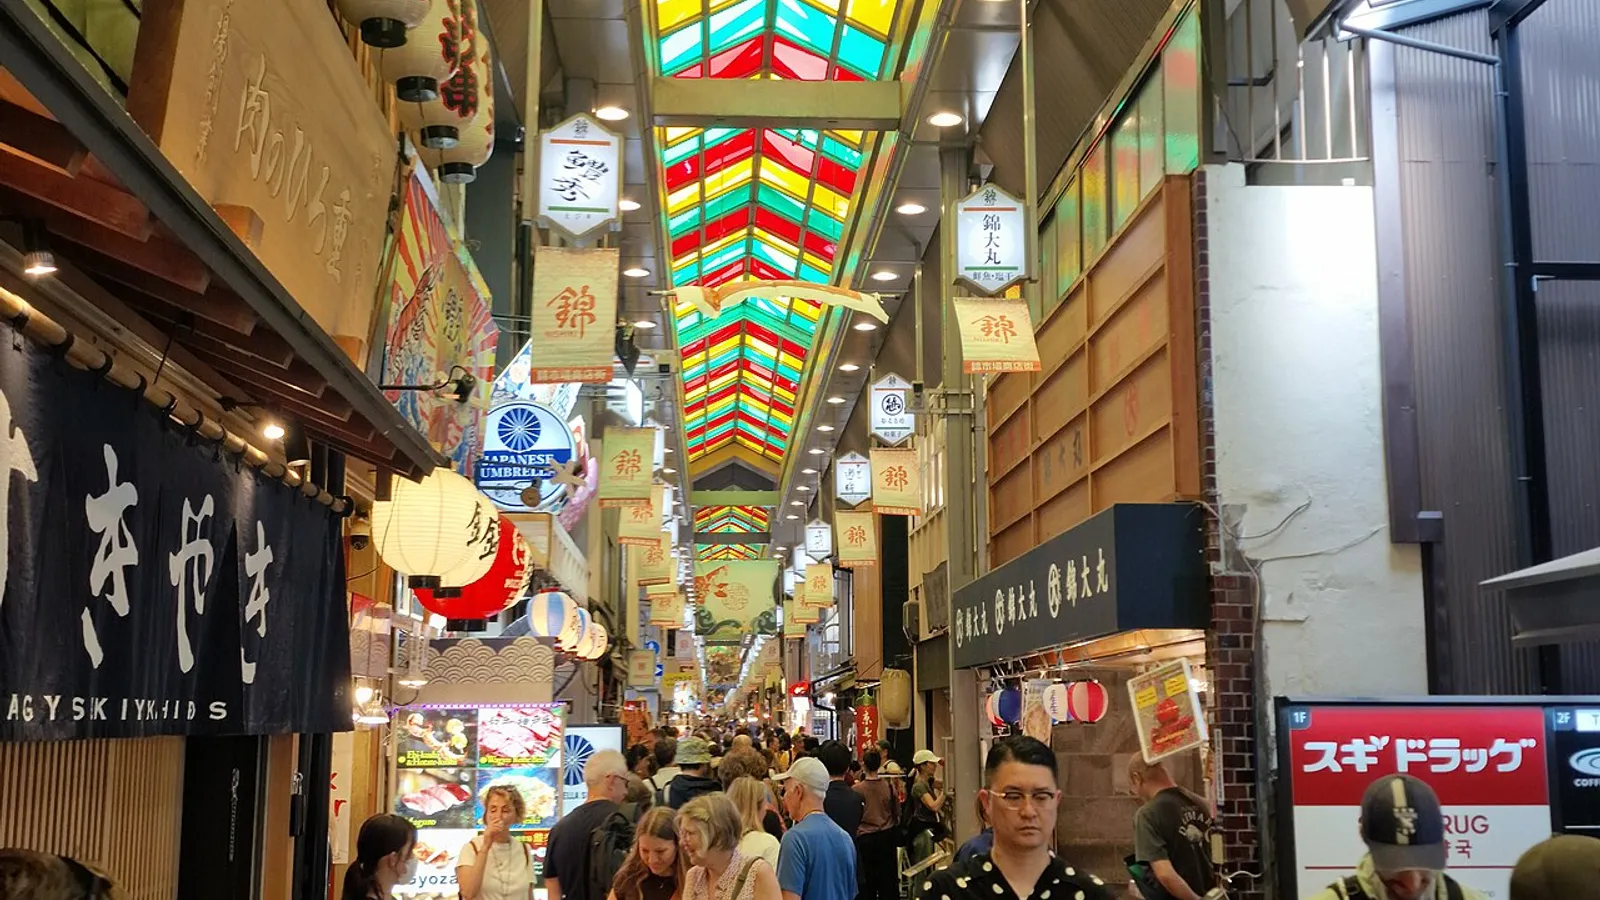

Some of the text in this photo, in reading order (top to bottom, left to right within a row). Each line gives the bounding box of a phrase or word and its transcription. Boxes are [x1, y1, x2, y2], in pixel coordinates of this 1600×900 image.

[982, 214, 1001, 265] 錦大丸
[545, 284, 597, 339] 錦
[971, 315, 1018, 344] 錦
[609, 448, 642, 481] 錦
[880, 465, 909, 492] 錦
[844, 525, 867, 548] 錦
[1066, 548, 1109, 607] 錦大丸
[1294, 712, 1307, 723] 1F
[1557, 712, 1571, 724] 2F
